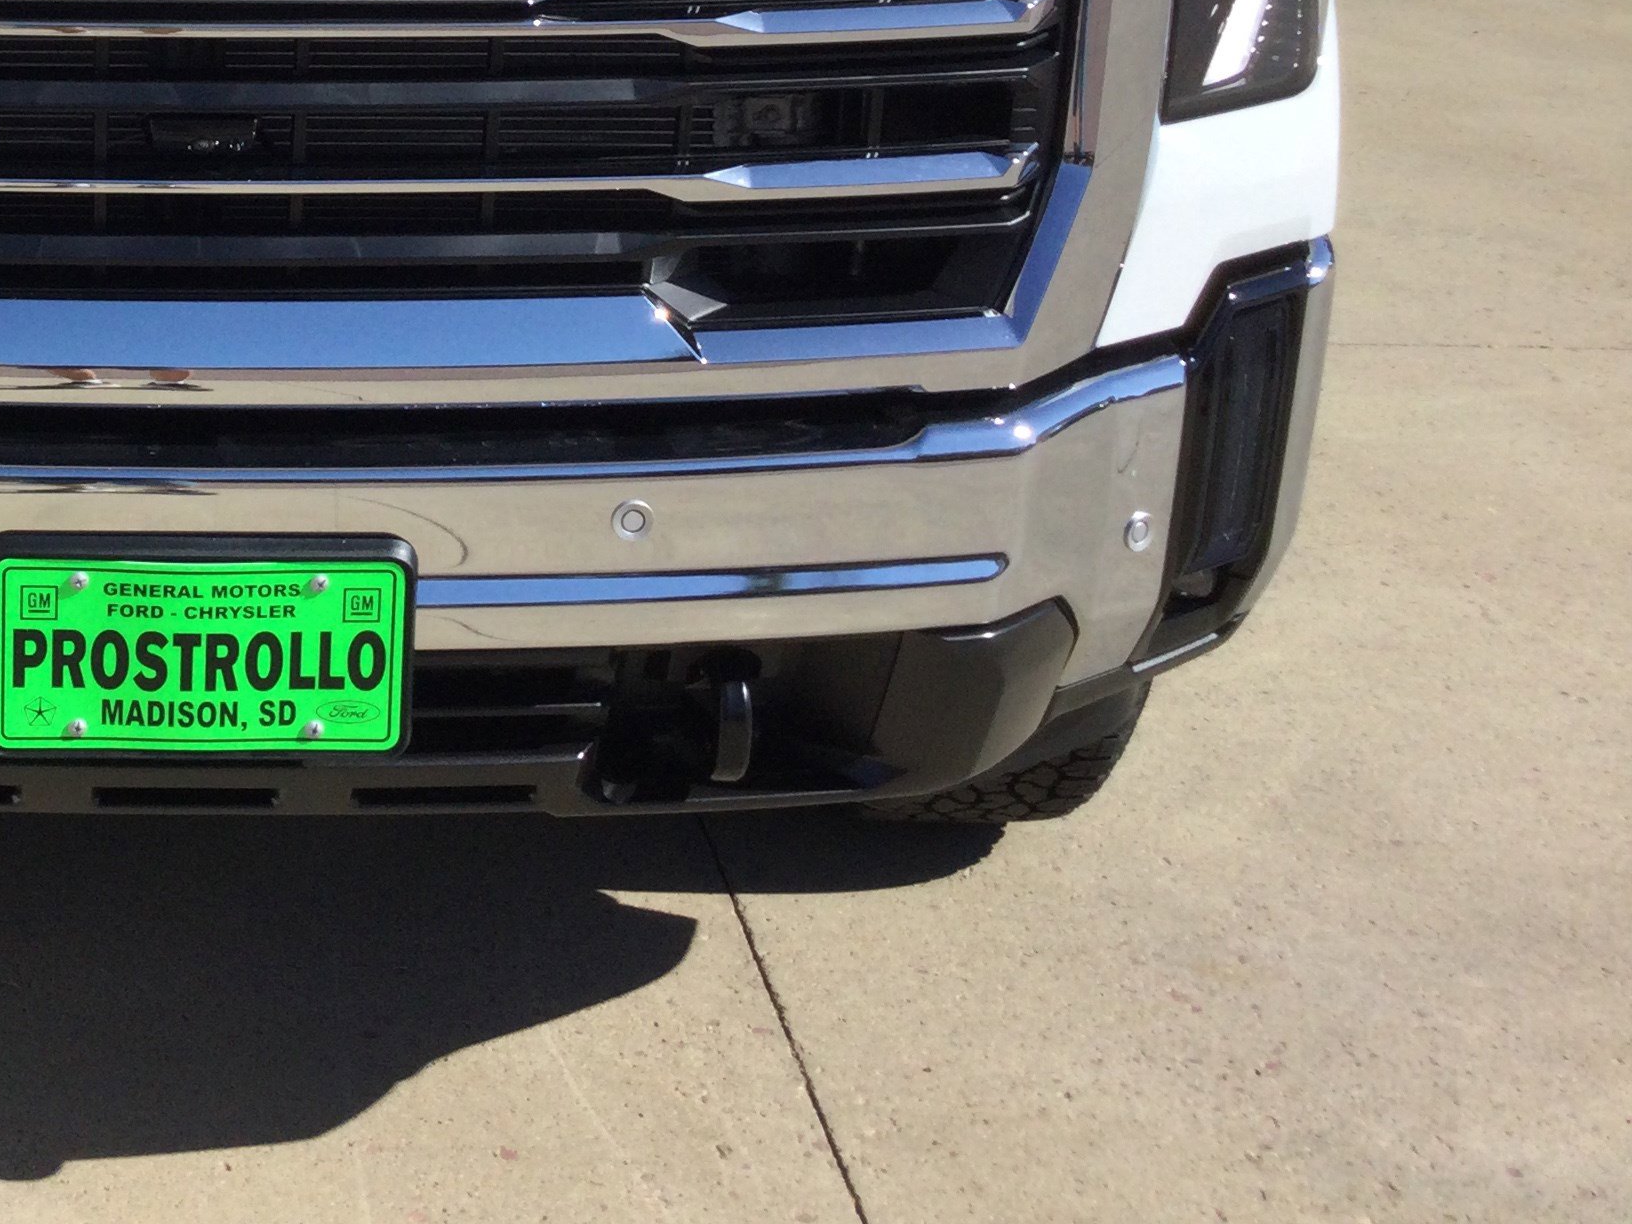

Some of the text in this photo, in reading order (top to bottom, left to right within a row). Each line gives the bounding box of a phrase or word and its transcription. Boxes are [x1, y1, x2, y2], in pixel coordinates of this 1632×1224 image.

[103, 582, 301, 599] GENERAL MOTORS
[27, 591, 51, 610] GM
[350, 595, 374, 611] GM
[107, 603, 165, 619] FORD
[185, 603, 296, 620] CHRYSLER
[12, 628, 386, 693] PROSTROLLO
[100, 699, 296, 731] MADISON, SD
[328, 705, 368, 719] Ford
